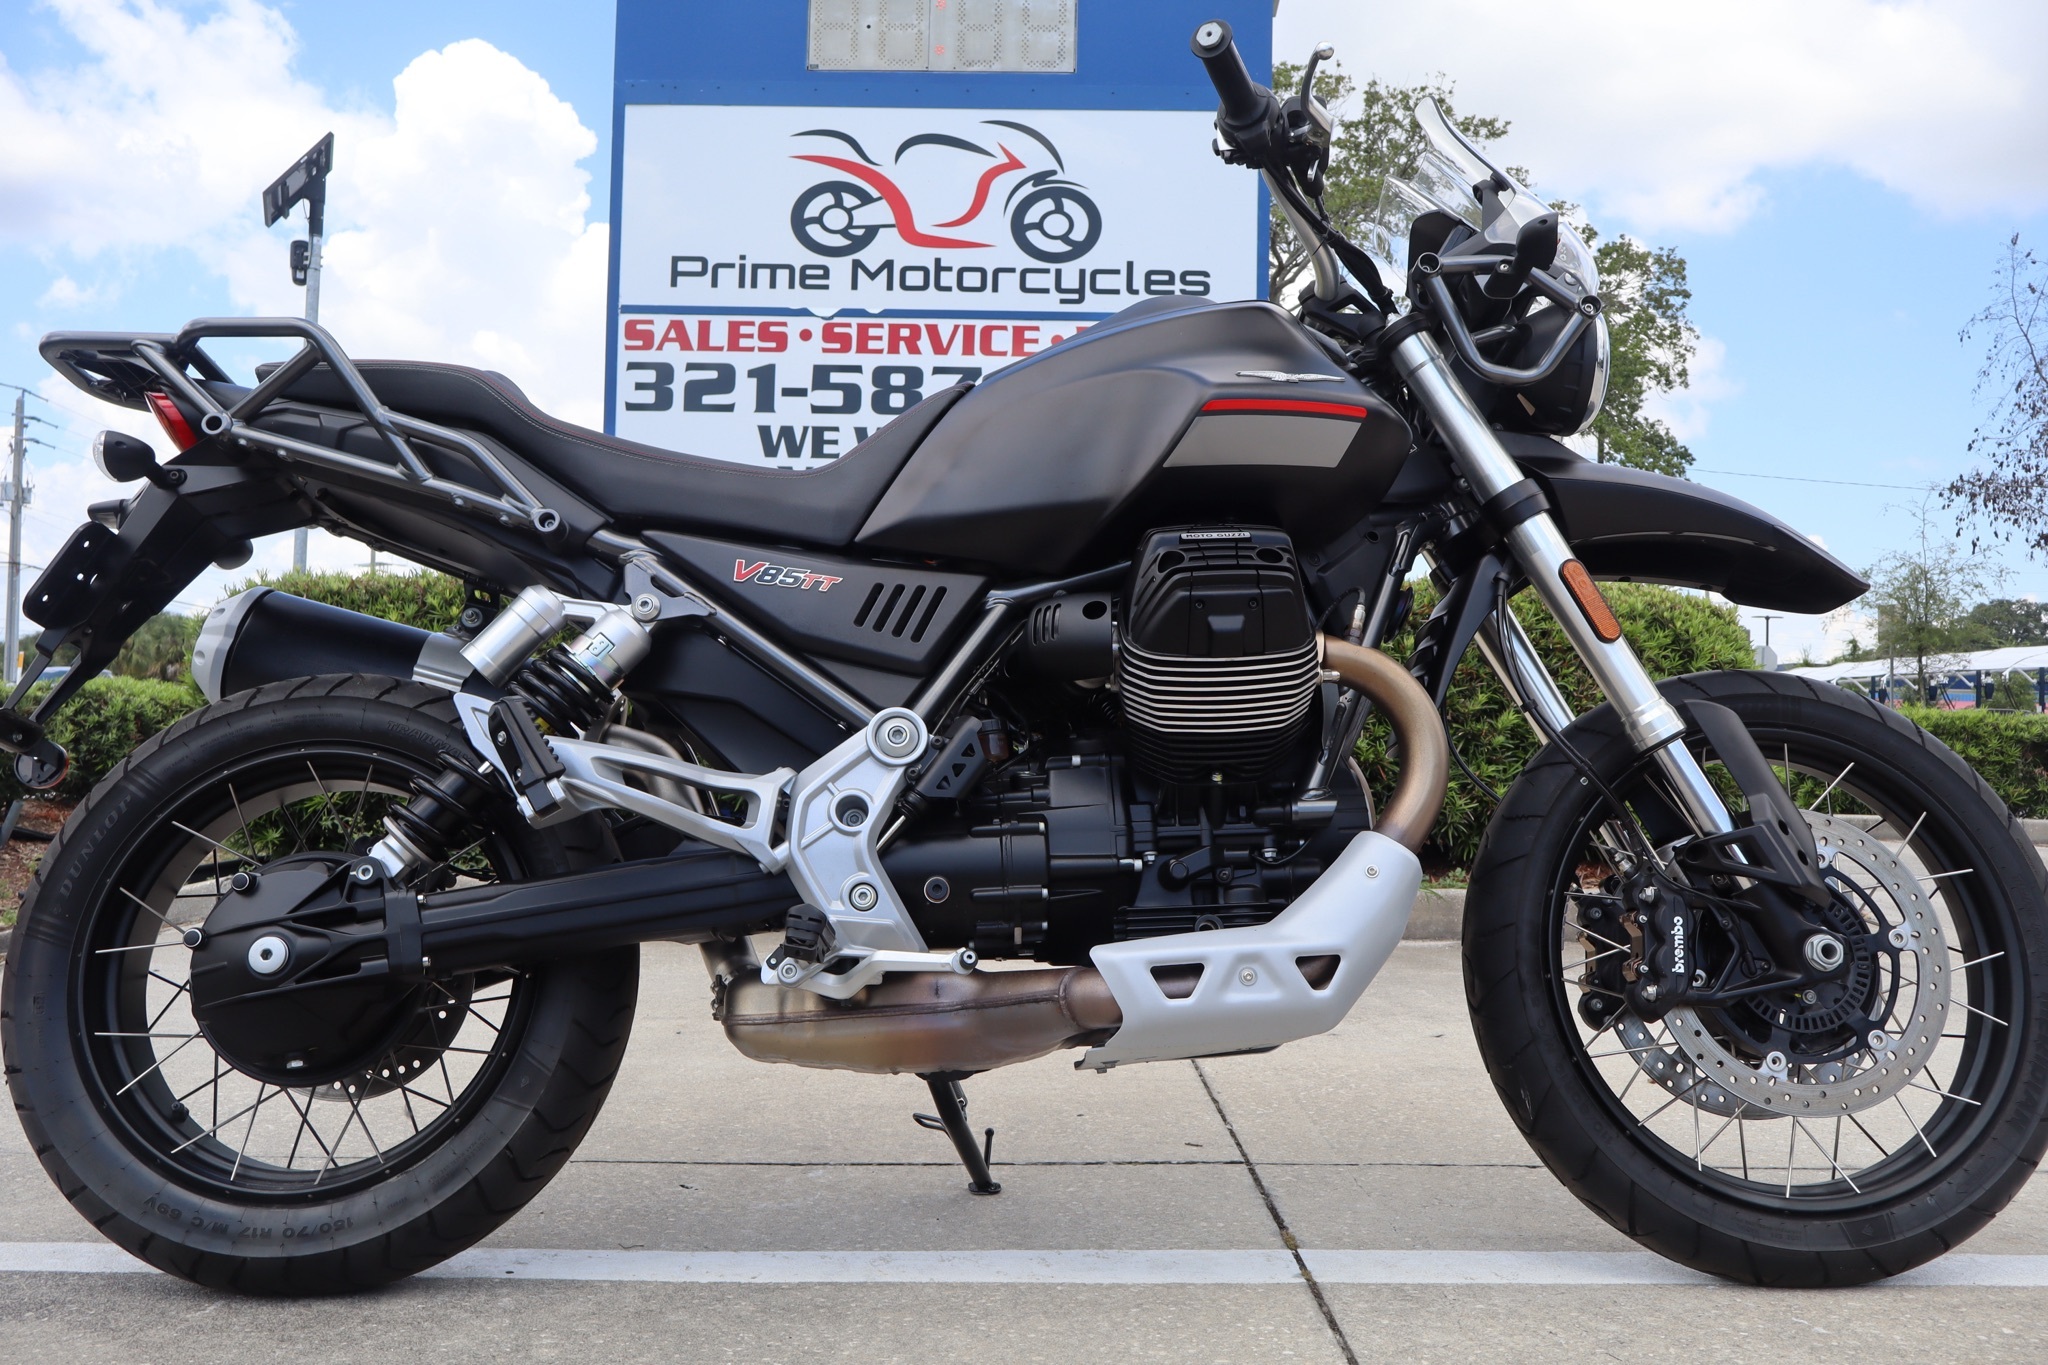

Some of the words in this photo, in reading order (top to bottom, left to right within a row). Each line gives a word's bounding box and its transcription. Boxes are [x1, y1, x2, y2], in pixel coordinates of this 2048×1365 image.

[670, 254, 830, 290] Prime
[851, 257, 1211, 304] Motorcycles
[624, 319, 789, 352] SALES
[821, 322, 1041, 357] SERVICE
[757, 425, 840, 459] WE
[734, 559, 843, 591] V85TT
[60, 795, 132, 899] DUNLOP
[1670, 916, 1685, 973] brembo
[283, 1216, 354, 1239] 150/70
